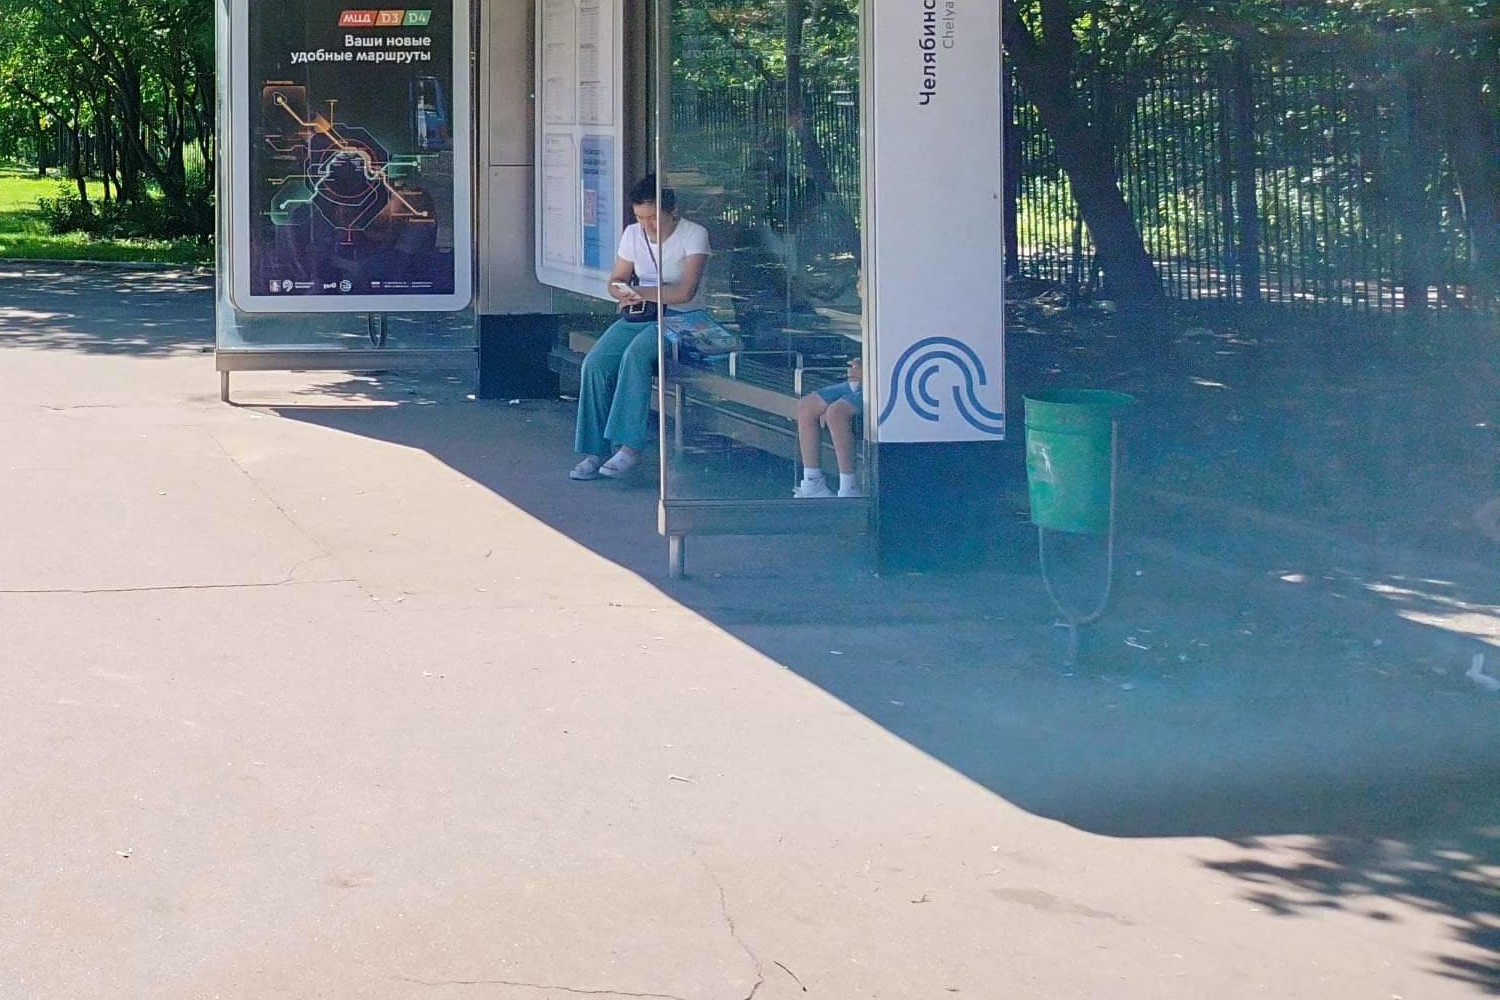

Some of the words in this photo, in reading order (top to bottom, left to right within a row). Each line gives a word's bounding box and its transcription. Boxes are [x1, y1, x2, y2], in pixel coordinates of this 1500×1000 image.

[345, 34, 383, 47] Ваши
[386, 36, 431, 47] новые
[291, 49, 353, 64] удобные
[356, 50, 431, 63] маршруты
